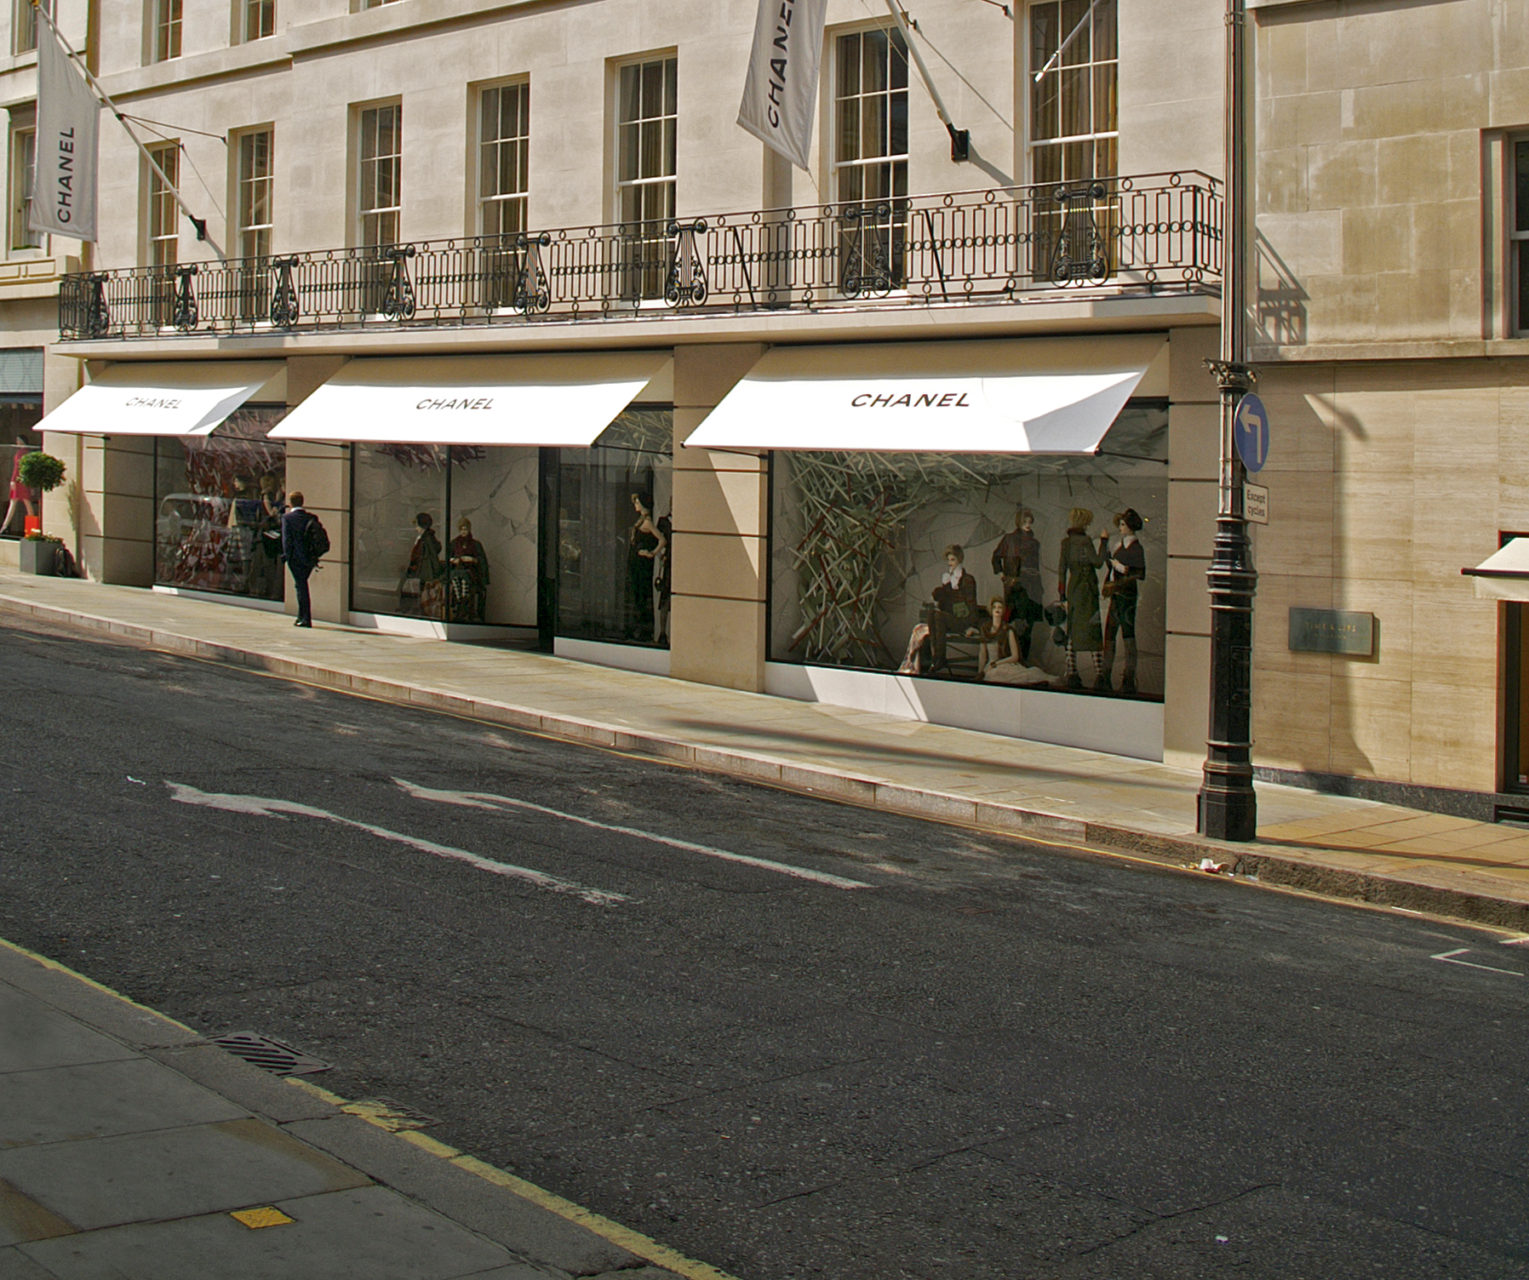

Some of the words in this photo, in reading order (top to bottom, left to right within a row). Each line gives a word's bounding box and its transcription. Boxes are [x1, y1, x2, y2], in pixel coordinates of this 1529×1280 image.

[57, 127, 74, 223] CHANEL
[125, 397, 182, 409] CHANEL
[416, 398, 493, 410] CHANEL
[851, 393, 969, 407] CHANEL
